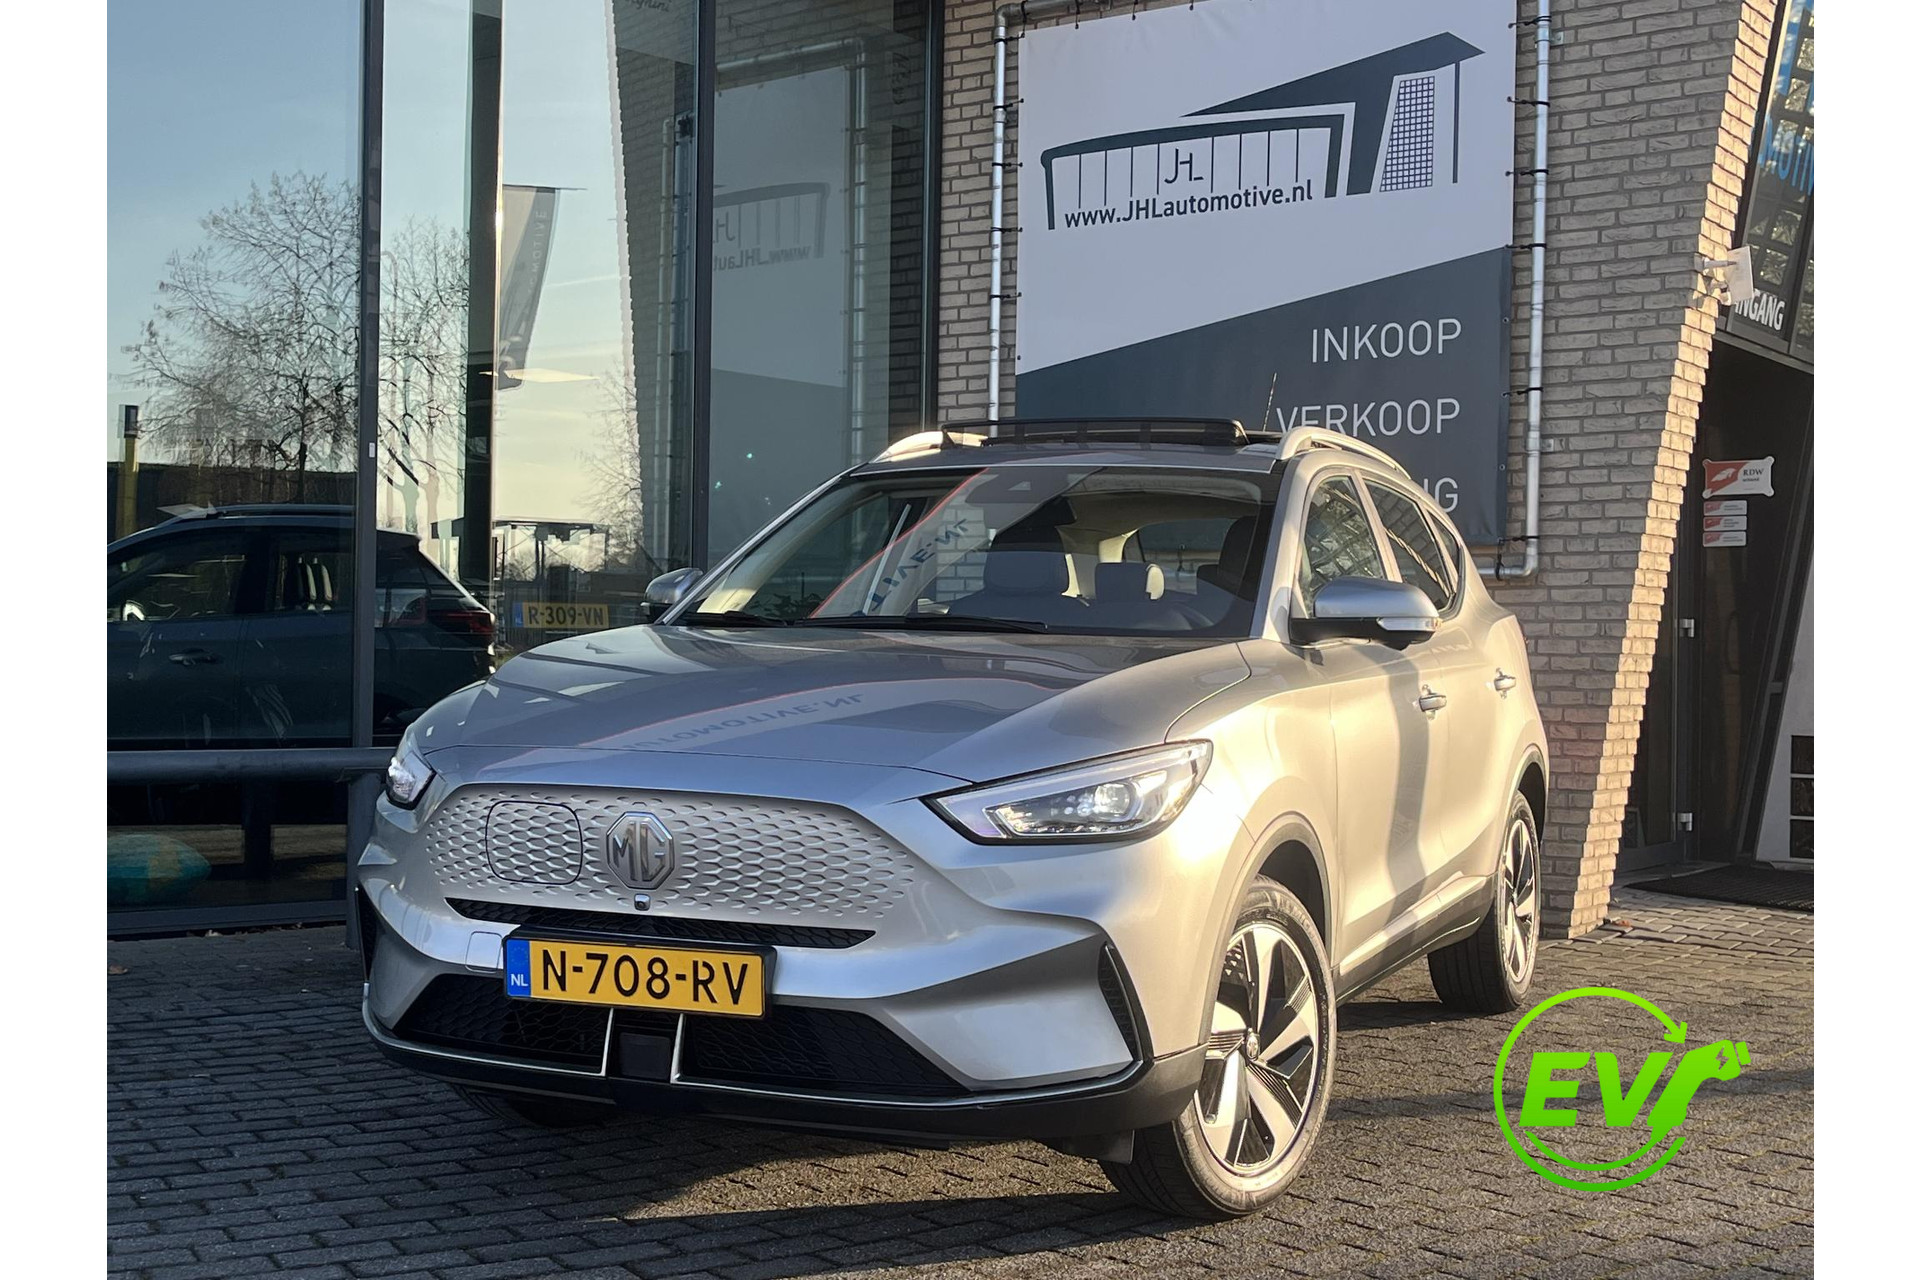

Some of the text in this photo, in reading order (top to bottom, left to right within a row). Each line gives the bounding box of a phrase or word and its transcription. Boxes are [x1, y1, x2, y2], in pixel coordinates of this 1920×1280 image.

[1064, 180, 1313, 229] www.JHLautomotive.nl
[1311, 318, 1462, 363] INKOOP
[1276, 398, 1461, 437] VERKOOP
[1743, 468, 1764, 476] RDW
[528, 606, 604, 626] R-309-VN
[611, 820, 668, 883] MG
[510, 973, 528, 987] NL
[541, 949, 749, 1006] N-708-RV
